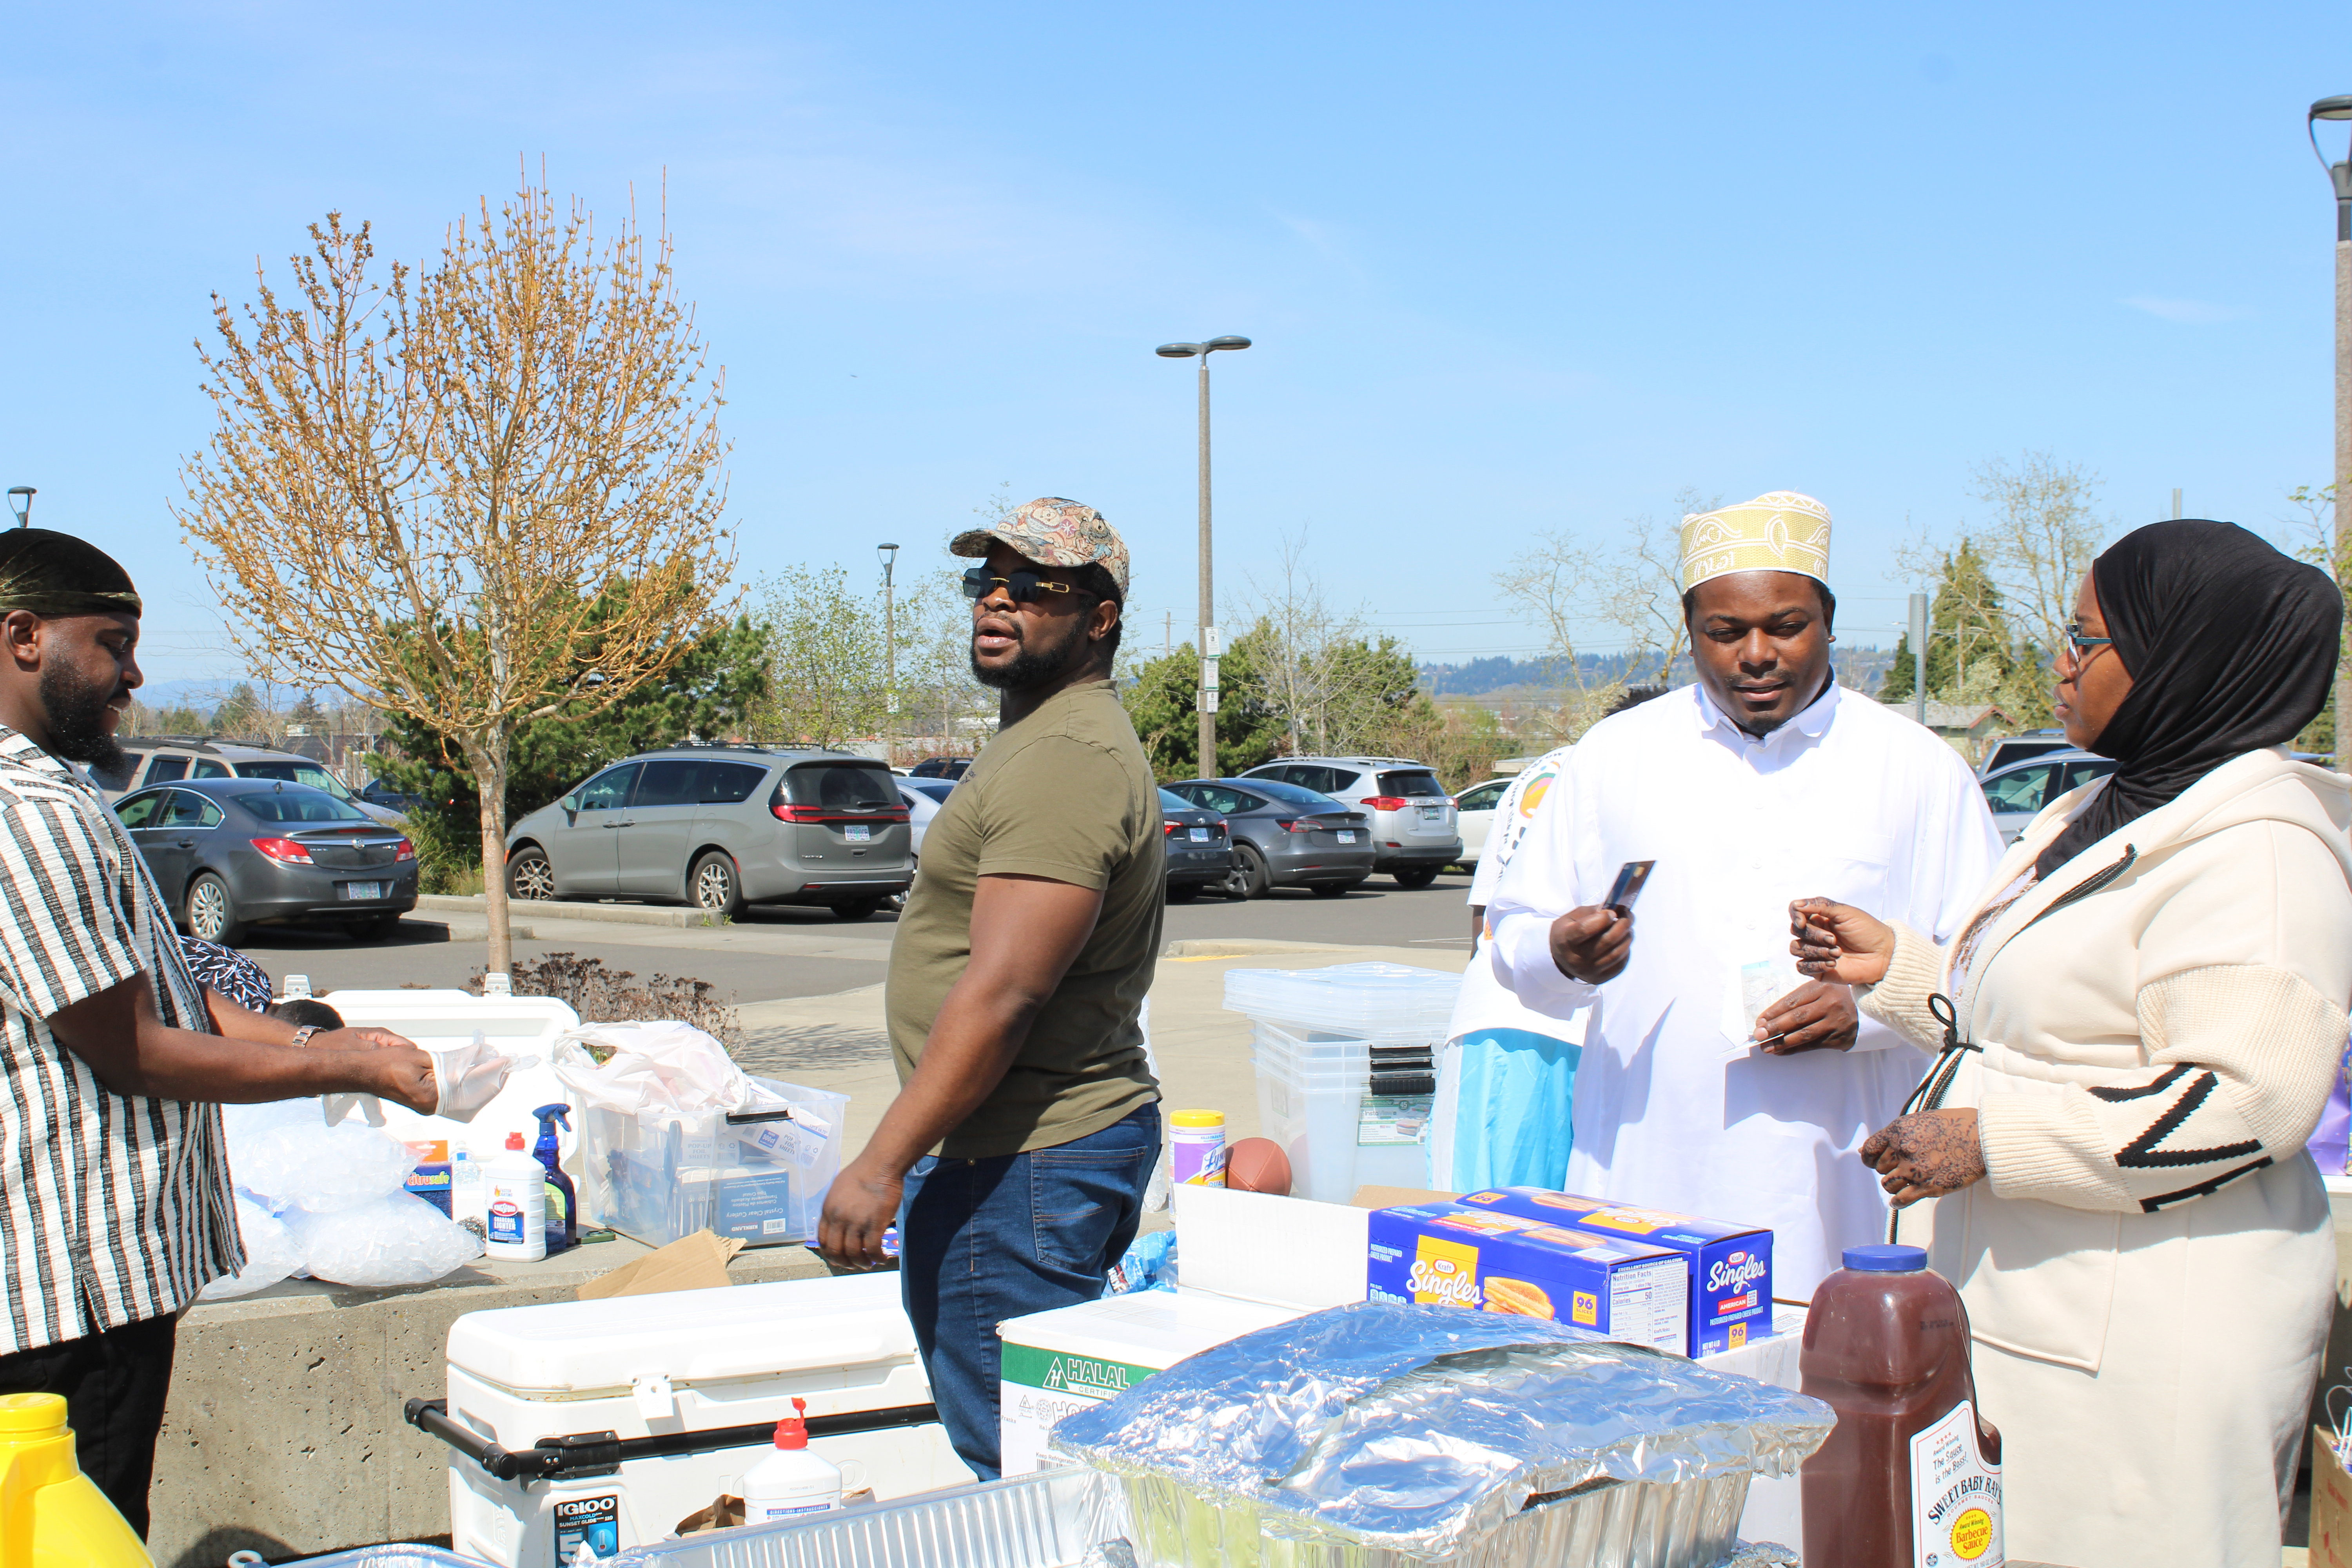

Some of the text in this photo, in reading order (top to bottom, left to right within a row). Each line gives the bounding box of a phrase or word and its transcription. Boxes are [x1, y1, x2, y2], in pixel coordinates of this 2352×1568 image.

[407, 1171, 450, 1186] citrusafe
[494, 1203, 516, 1214] KINGSFORD
[494, 1221, 516, 1230] LIGHTER
[1435, 1220, 1479, 1231] AMERICAN
[1370, 1243, 1403, 1258] PASTEURIZED PREPARED
[1370, 1251, 1393, 1263] CHEESE PRODUCT
[1438, 1262, 1452, 1272] Kraft
[1617, 1264, 1641, 1272] EXCELLENT
[1706, 1253, 1766, 1294] Singles
[1406, 1260, 1483, 1305] Singles
[1613, 1273, 1636, 1281] Nutrition
[1577, 1296, 1593, 1310] 96
[1612, 1291, 1652, 1305] Calories 50
[1720, 1299, 1746, 1310] AMERICAN
[1710, 1306, 1763, 1326] PASTEURIZED PREPARED CHEESE PRODUCT
[1731, 1327, 1744, 1338] 96
[1067, 1357, 1130, 1390] HALAL
[1079, 1386, 1116, 1398] CERTIFIE
[1001, 1415, 1016, 1424] Franks
[1933, 1444, 1945, 1456] Award
[1933, 1443, 1962, 1470] The Sauce
[1048, 1455, 1076, 1465] Refrigerated
[1935, 1451, 1967, 1484] is the Boss!
[558, 1497, 615, 1516] IGLOO
[1927, 1475, 2002, 1525] SWEET BABY RAY'S
[1947, 1495, 1994, 1517] GOURMET SAUCES
[1971, 1518, 1984, 1526] Winning
[1956, 1526, 1988, 1544] Barbecue
[1963, 1537, 1983, 1554] Sauce
